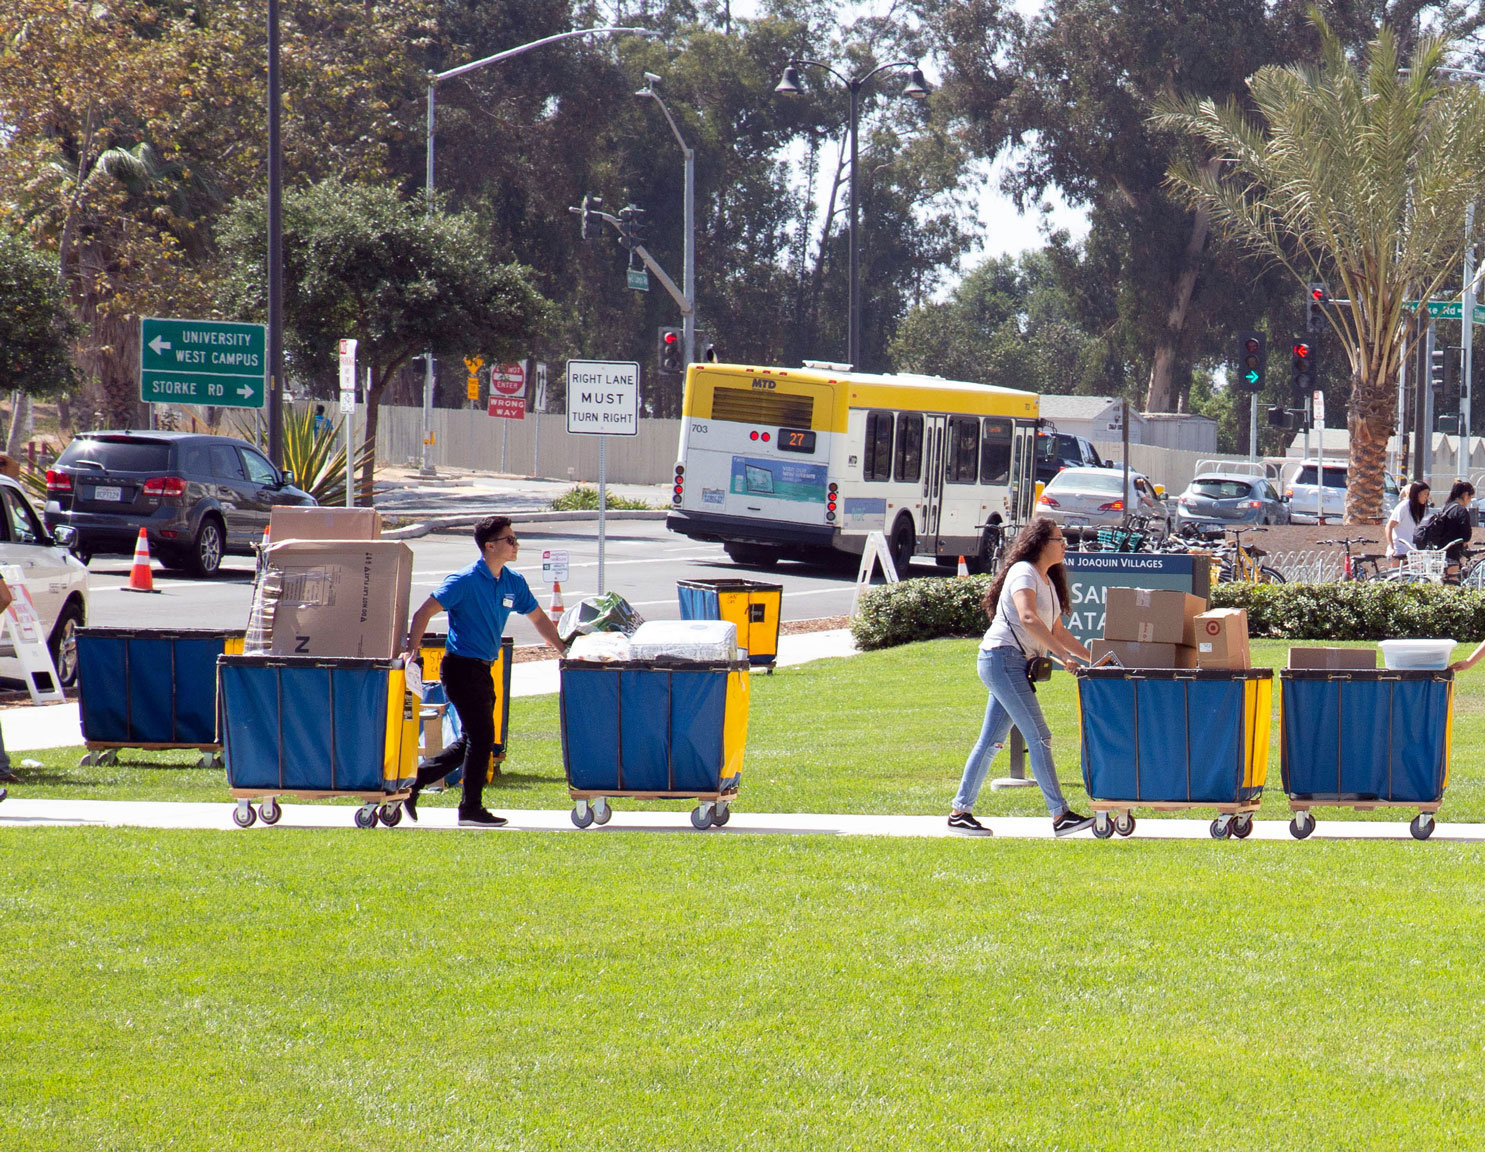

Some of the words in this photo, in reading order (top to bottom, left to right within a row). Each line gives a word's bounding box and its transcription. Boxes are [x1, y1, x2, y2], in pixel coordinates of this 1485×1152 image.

[1443, 306, 1456, 315] Rd
[182, 330, 251, 346] UNIVERSITY
[175, 350, 206, 363] WEST
[211, 352, 258, 366] CAMPUS
[572, 373, 602, 384] RIGHT
[606, 375, 634, 385] LANE
[752, 378, 776, 389] MTD
[152, 380, 197, 395] STORKE
[208, 384, 224, 396] RD
[490, 399, 524, 408] WRONG
[581, 392, 624, 405] MUST
[572, 412, 599, 422] TURN
[603, 413, 633, 423] RIGHT
[692, 424, 708, 433] 703
[789, 433, 804, 446] 27
[1077, 557, 1118, 568] JOAQUIN
[1120, 558, 1163, 568] VILLAGES
[361, 609, 367, 617] DO
